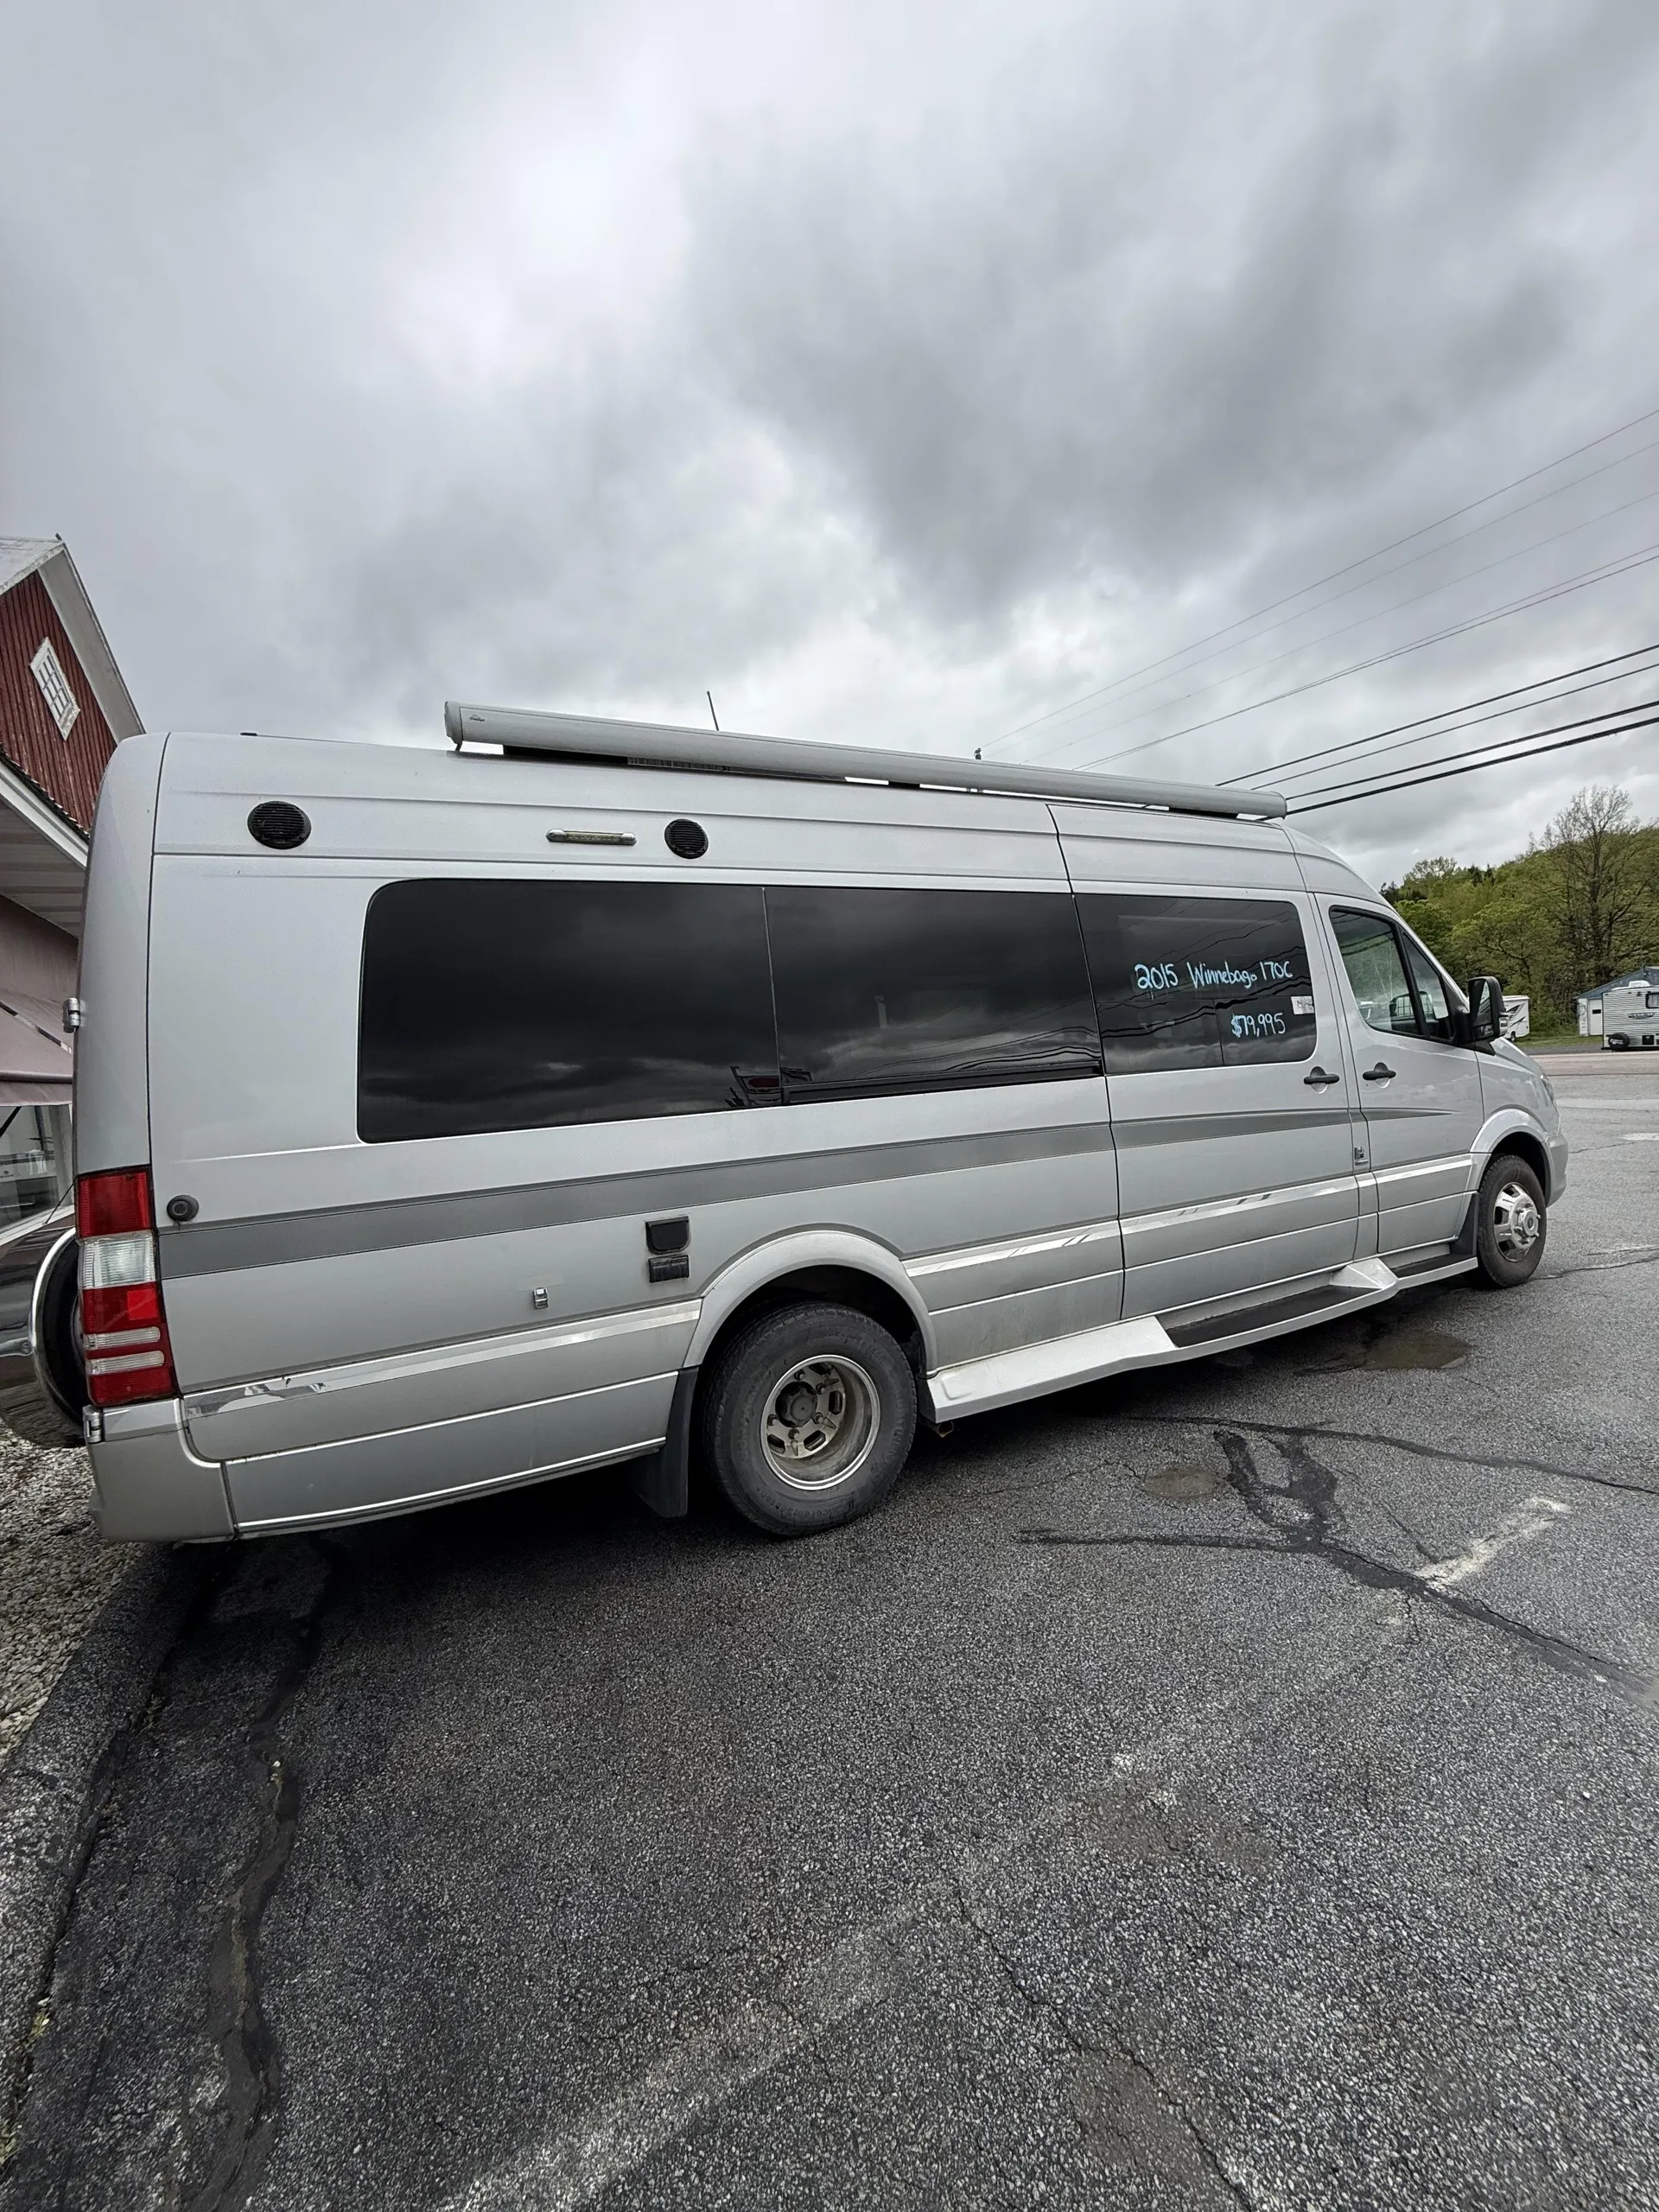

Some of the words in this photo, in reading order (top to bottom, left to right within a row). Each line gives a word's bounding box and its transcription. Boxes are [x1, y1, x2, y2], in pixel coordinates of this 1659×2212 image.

[1134, 963, 1179, 989] 2015
[1186, 960, 1258, 988] Winnebago
[1259, 960, 1294, 982] 170C
[1230, 1013, 1286, 1038] $79,995
